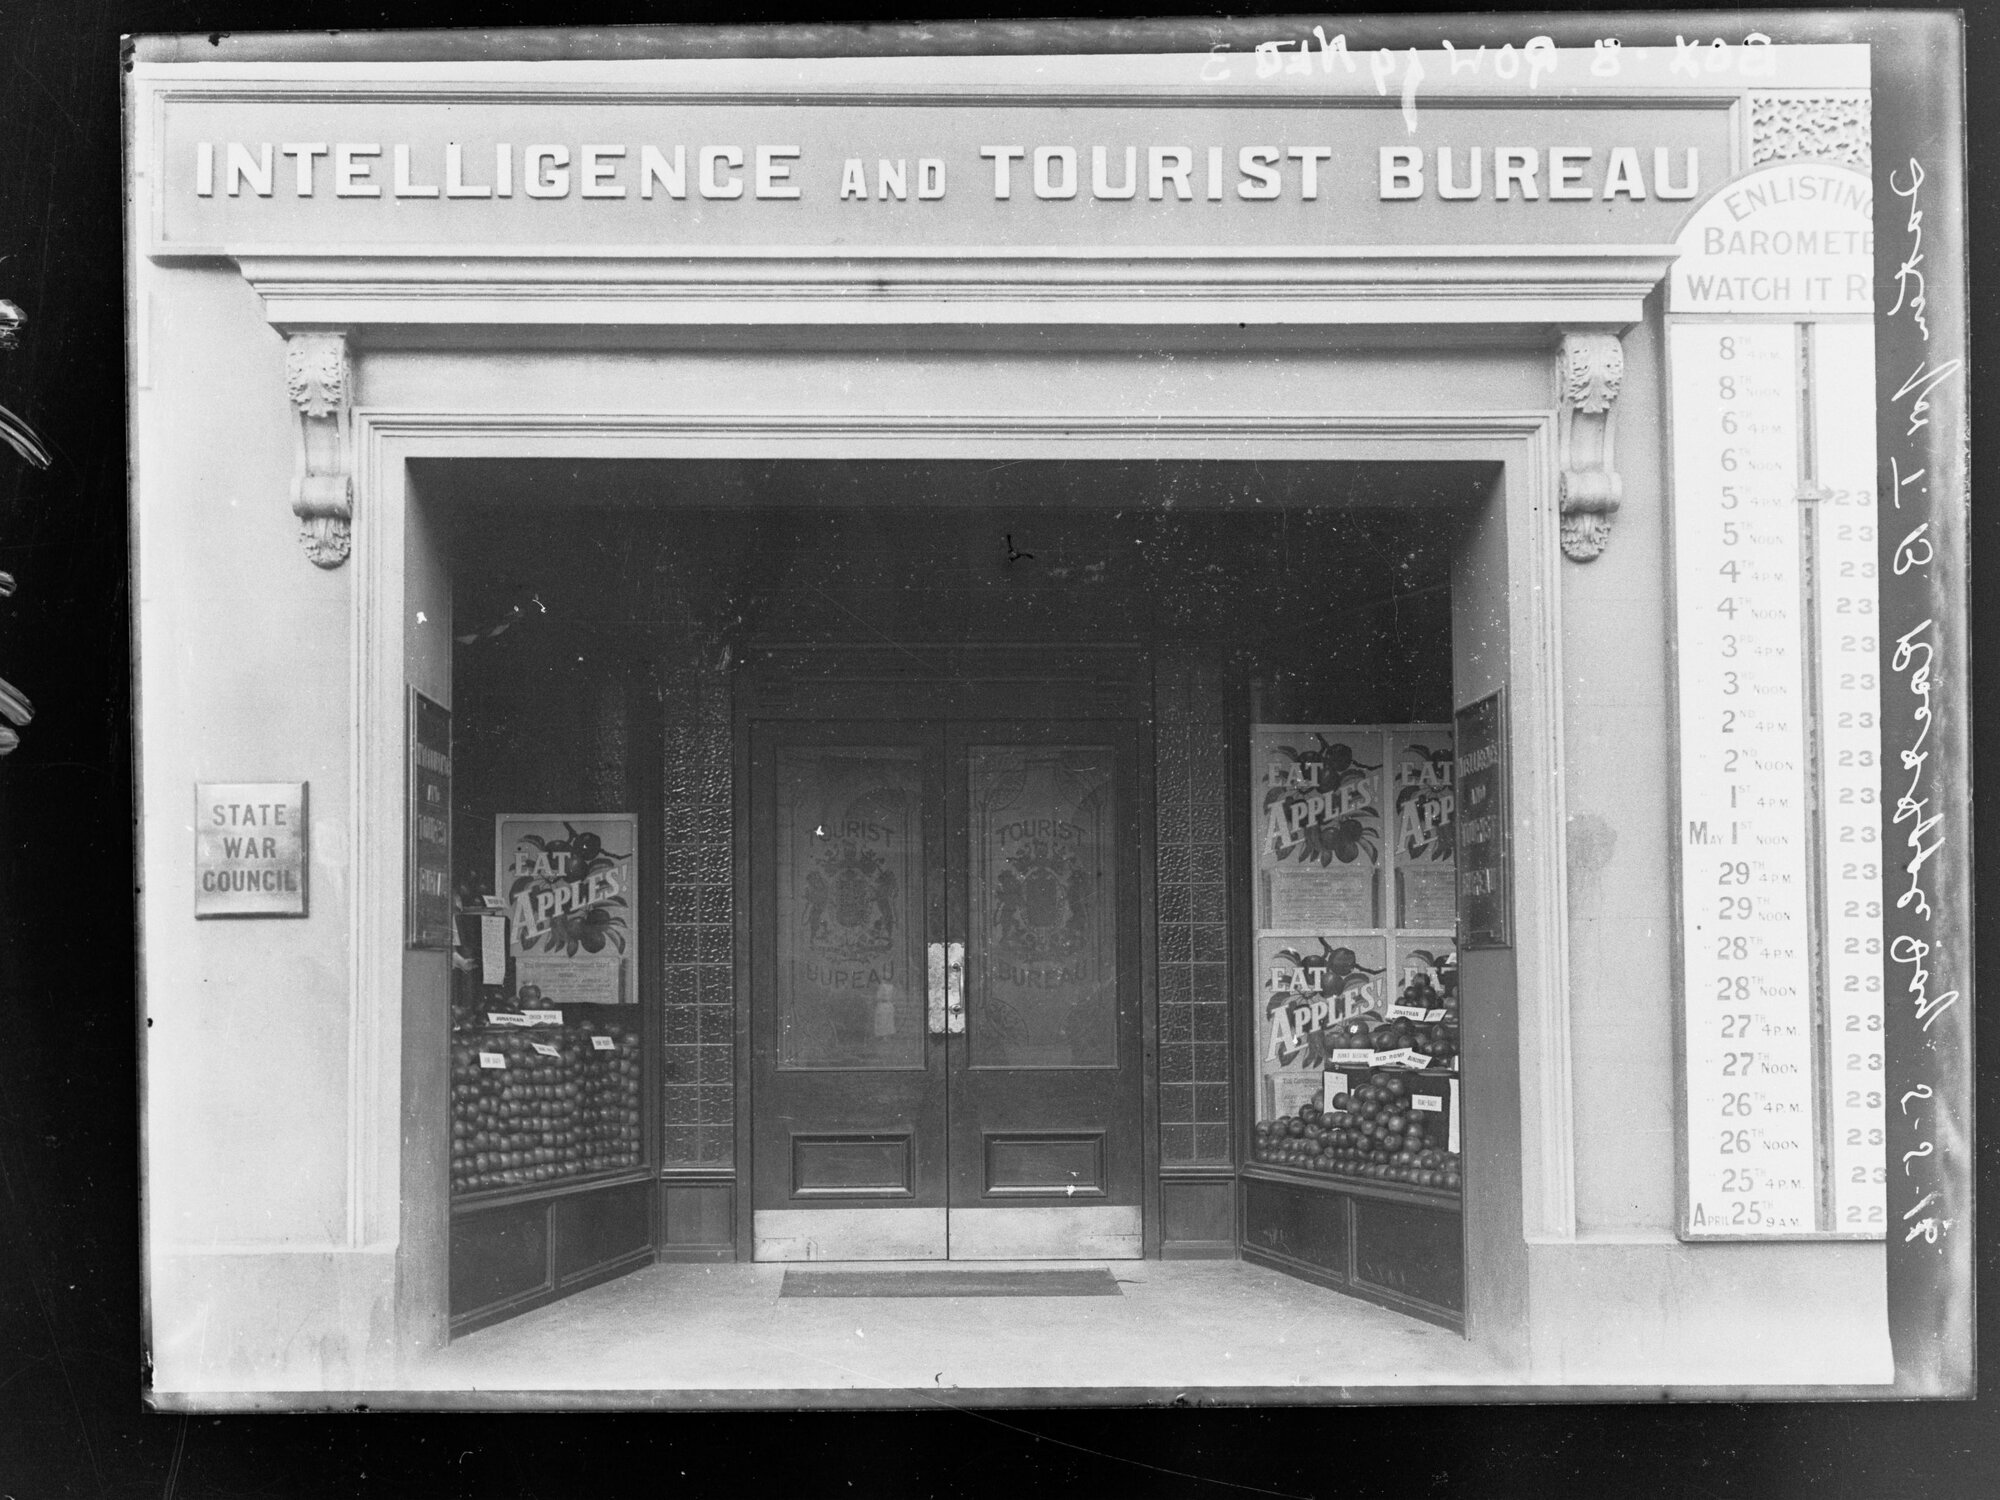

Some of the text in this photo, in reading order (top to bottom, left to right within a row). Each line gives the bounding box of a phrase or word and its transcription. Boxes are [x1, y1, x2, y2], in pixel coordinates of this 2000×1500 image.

[196, 143, 1701, 203] INTELLIGENCE AND TOURIST BUREAU
[1687, 274, 1790, 301] WATCH
[1805, 277, 1832, 301] IT
[1268, 762, 1324, 788] EAT
[1401, 761, 1453, 787] EAT
[212, 803, 287, 826] STATE
[223, 837, 277, 859] WAR
[513, 851, 572, 877] EAT
[202, 869, 298, 893] COUNCIL
[1269, 966, 1327, 992] EAT
[1393, 1009, 1419, 1017] JONATHAN
